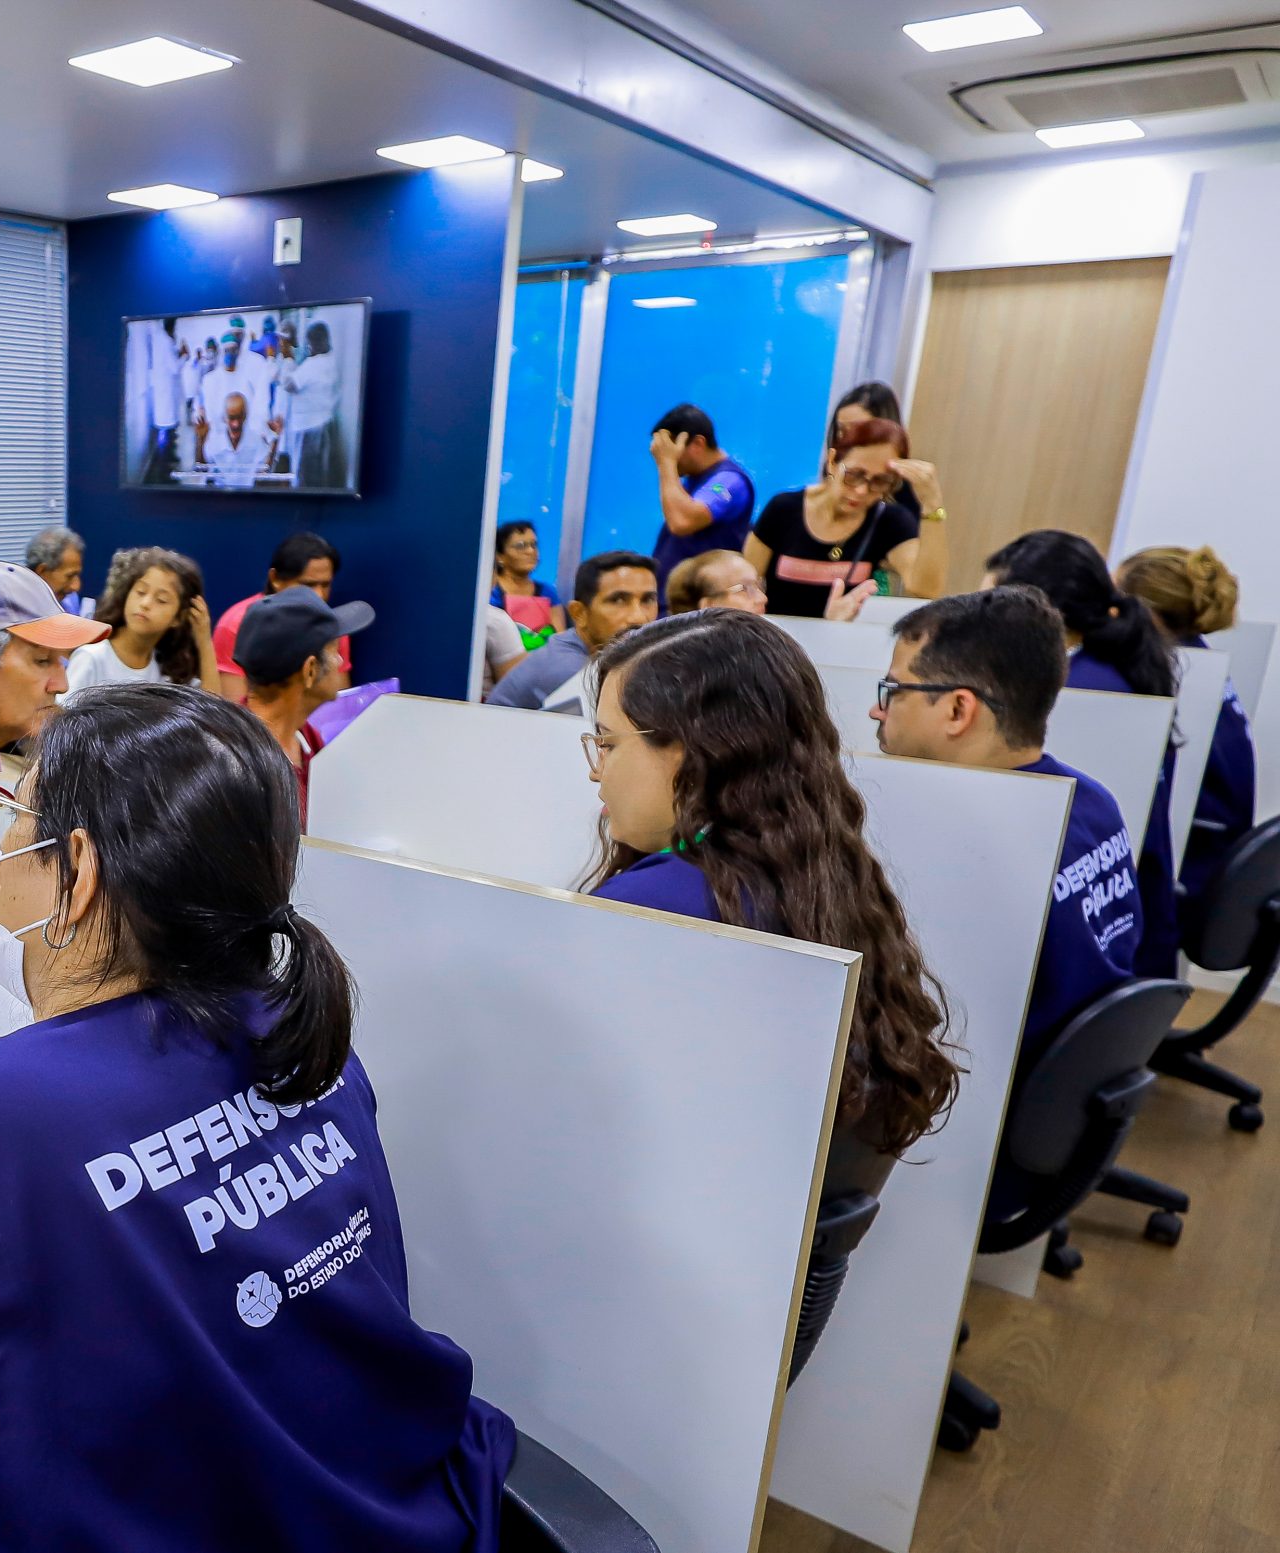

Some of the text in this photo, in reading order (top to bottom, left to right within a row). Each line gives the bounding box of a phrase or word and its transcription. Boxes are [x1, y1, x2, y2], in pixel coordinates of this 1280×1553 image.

[84, 1075, 345, 1212] DEFENS
[183, 1120, 357, 1254] PÚBLICA
[283, 1227, 354, 1283] DEFENSORIA
[288, 1281, 310, 1299] DO
[309, 1256, 344, 1290] ESTADO
[342, 1244, 361, 1264] DO
